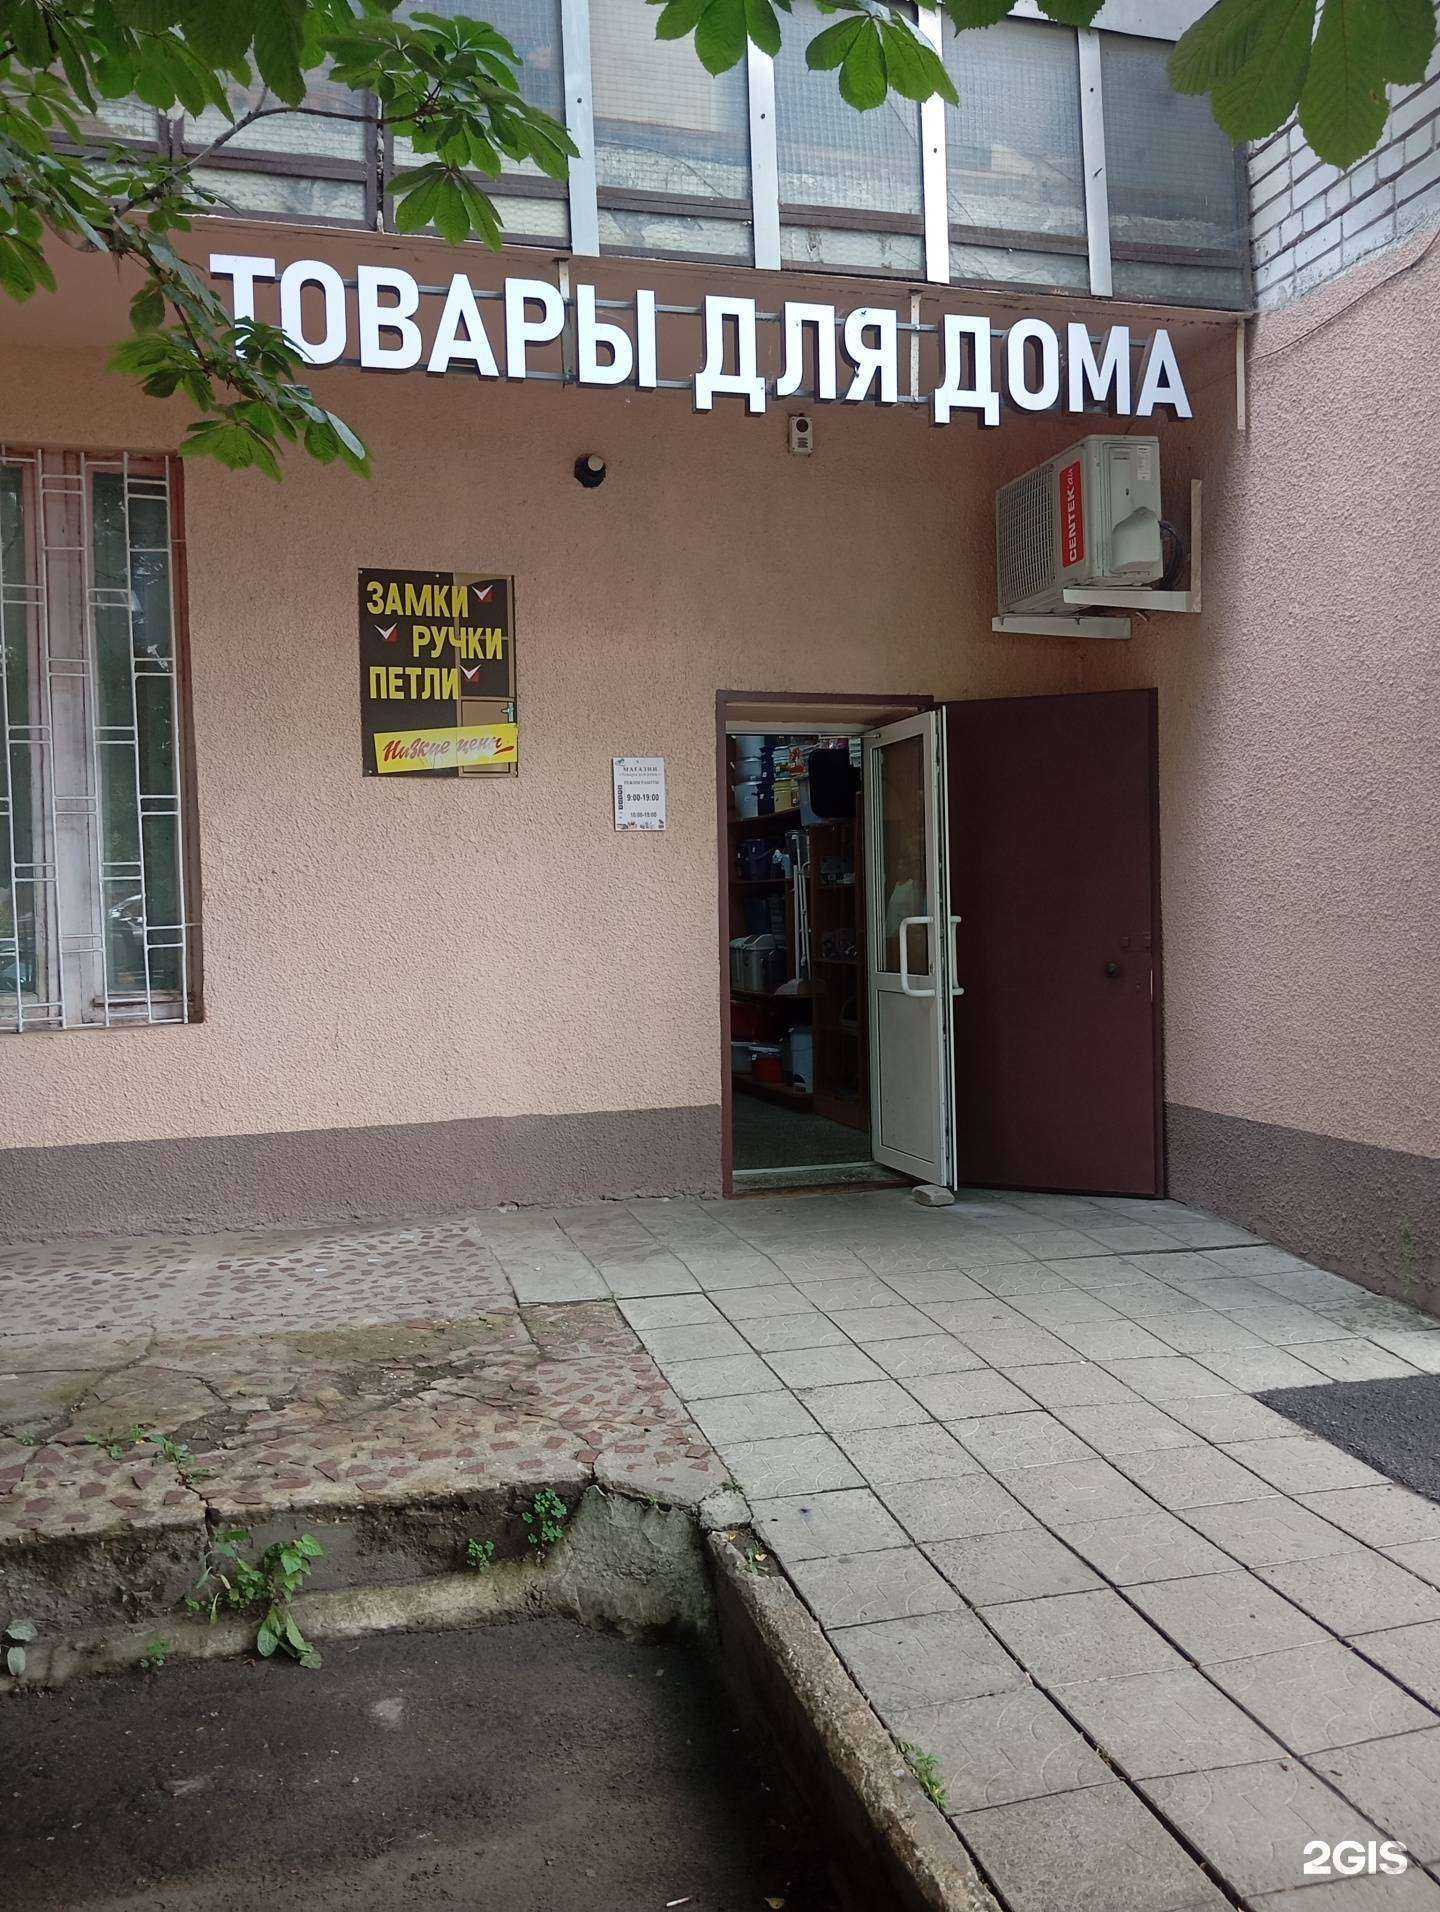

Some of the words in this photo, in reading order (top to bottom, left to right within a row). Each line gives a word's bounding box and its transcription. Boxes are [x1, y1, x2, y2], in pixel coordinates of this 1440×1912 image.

[209, 253, 658, 388] ТОВАРЫ
[695, 296, 898, 413] ДЛЯ
[935, 314, 1193, 427] ДОМА
[1067, 486, 1077, 562] CENTEK
[366, 580, 469, 619] ЗАМКИ
[412, 624, 503, 660] РУЧКИ
[369, 666, 460, 701] ПЕТЛИ
